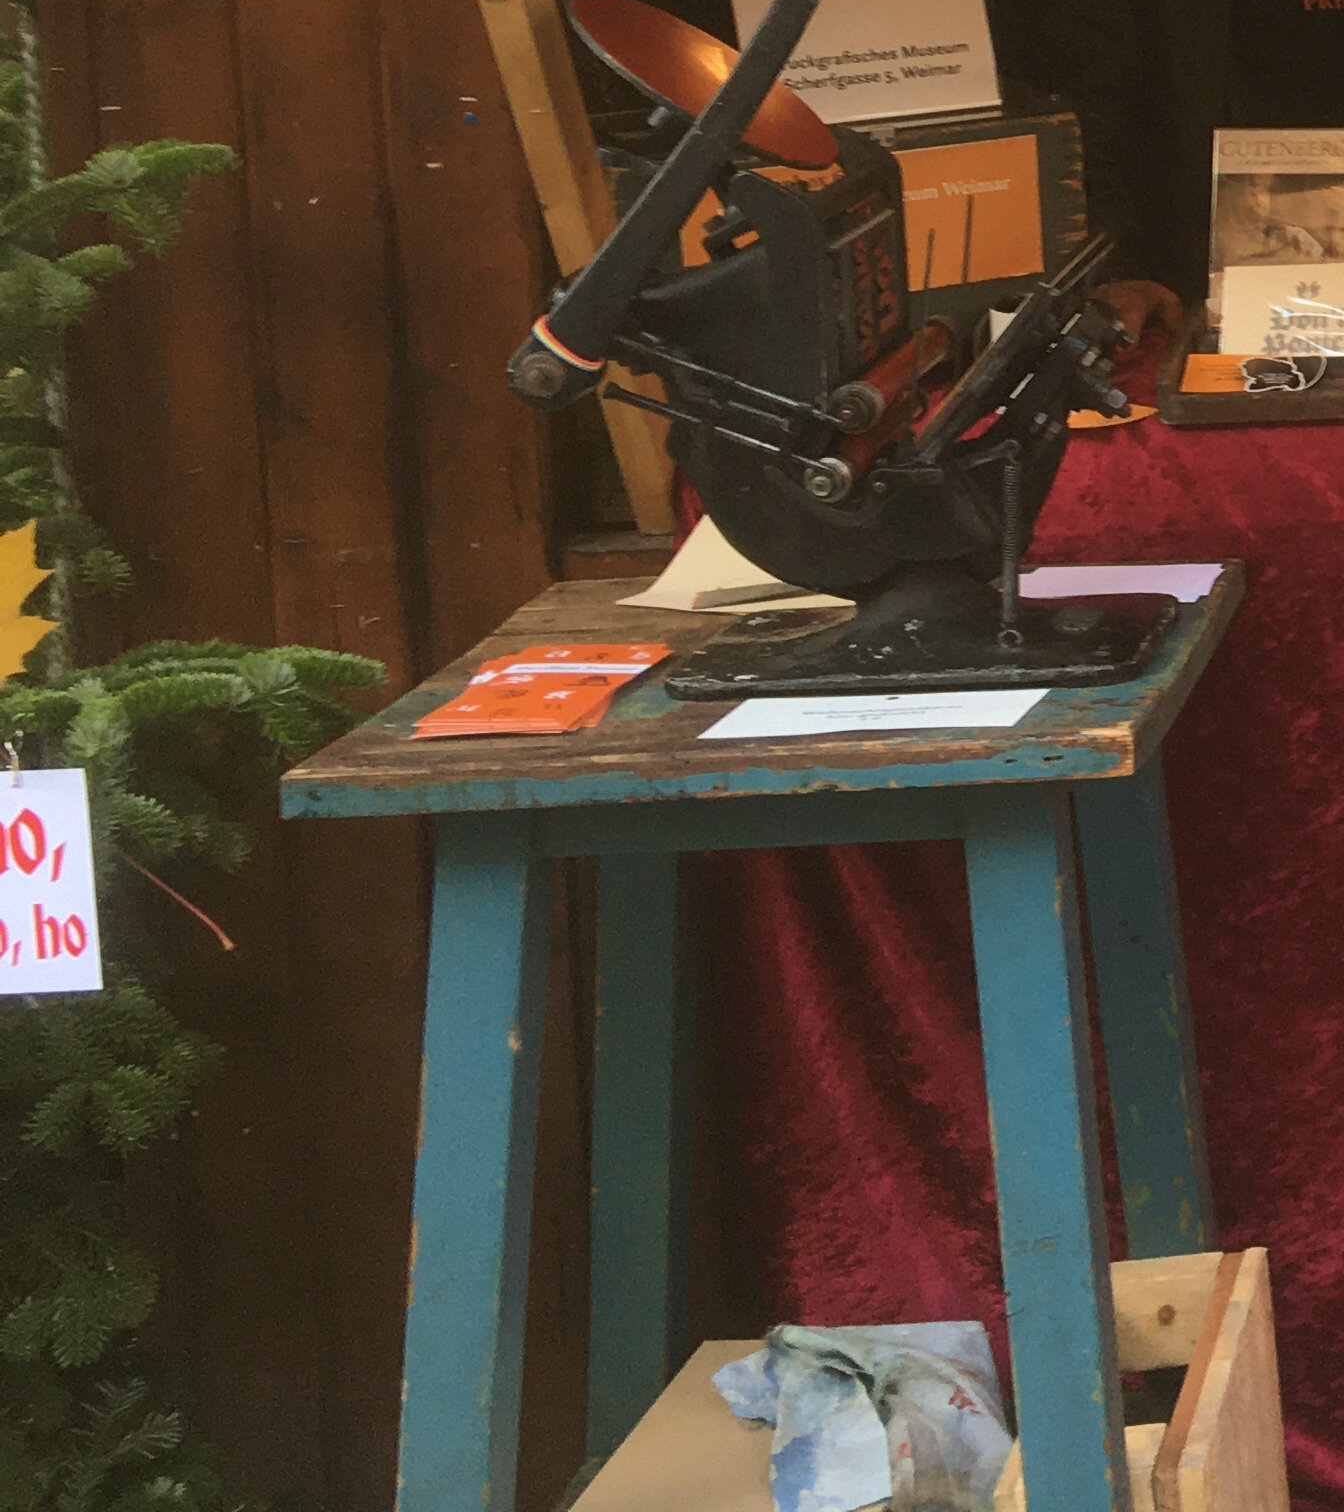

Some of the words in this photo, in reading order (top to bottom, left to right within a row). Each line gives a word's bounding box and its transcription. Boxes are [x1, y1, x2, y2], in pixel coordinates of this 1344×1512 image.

[901, 43, 970, 59] Museum
[0, 808, 67, 883] o,
[33, 904, 87, 959] ho
